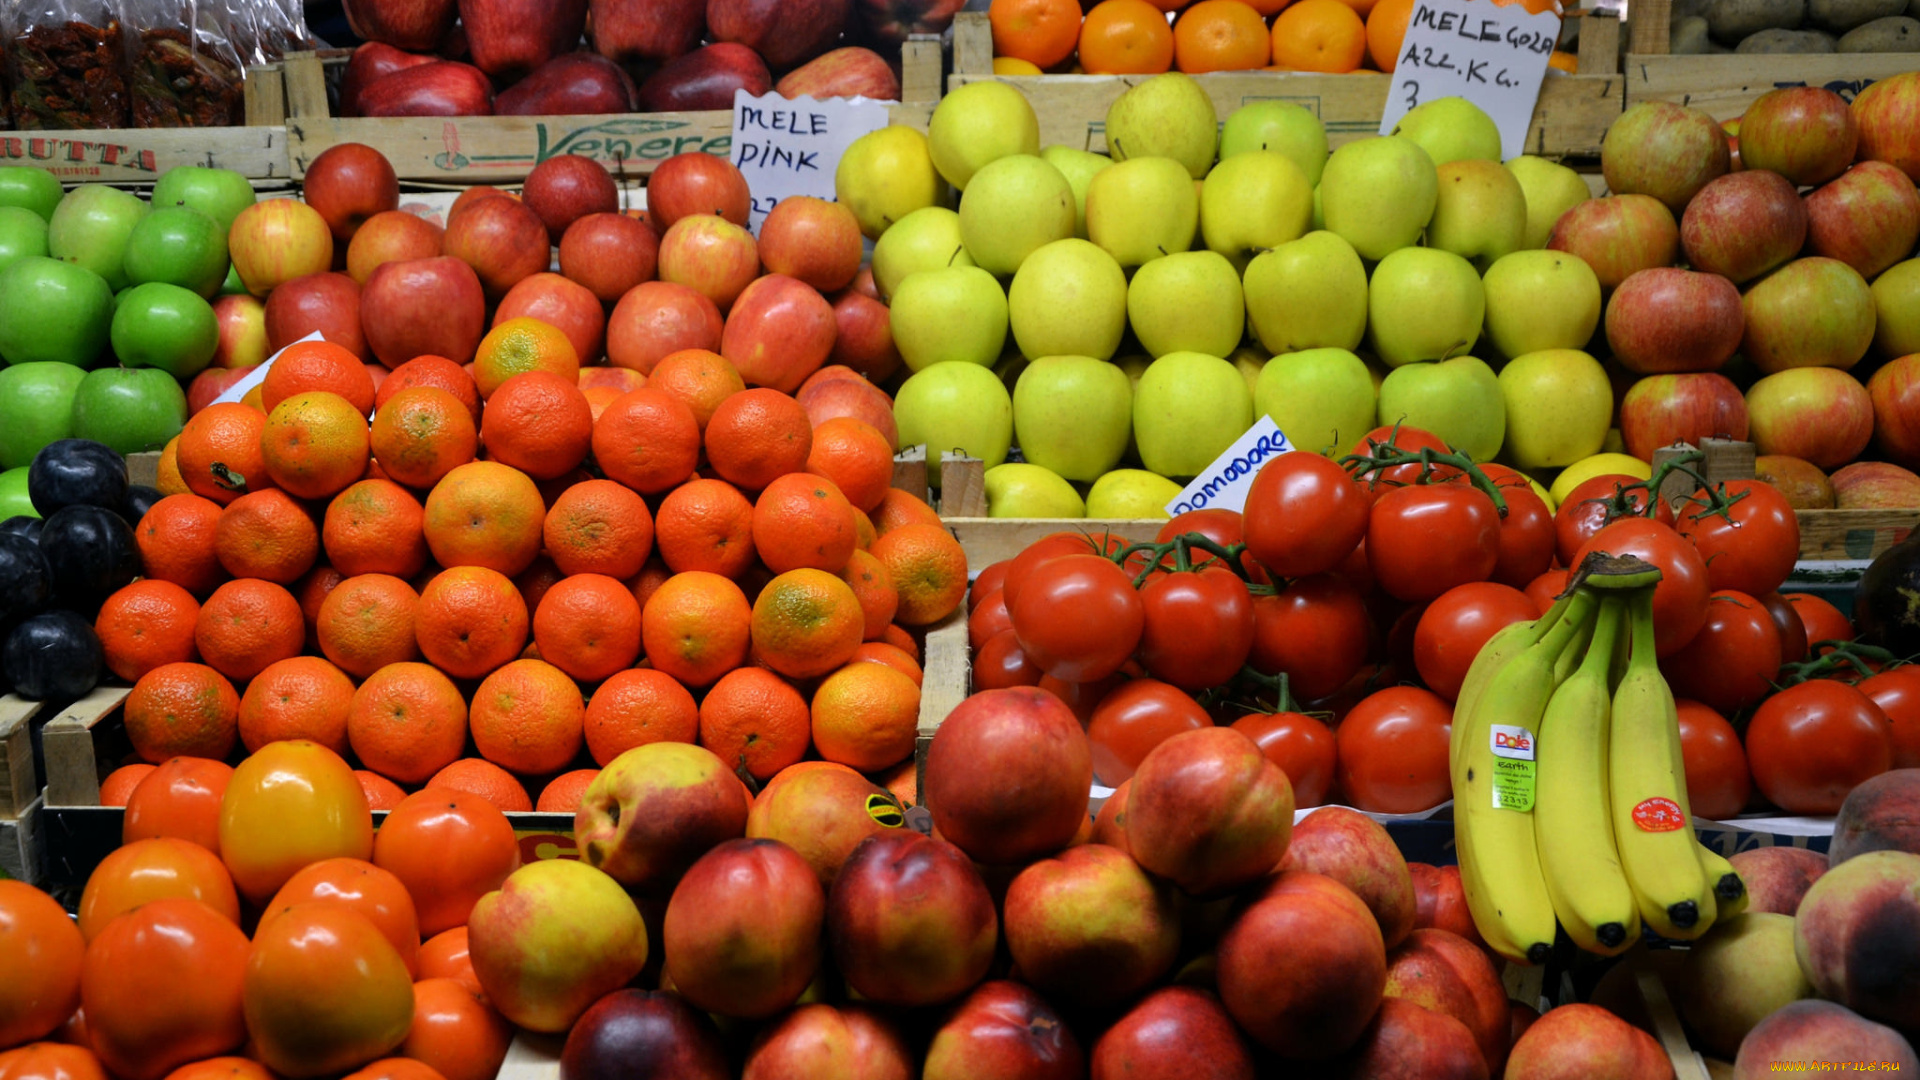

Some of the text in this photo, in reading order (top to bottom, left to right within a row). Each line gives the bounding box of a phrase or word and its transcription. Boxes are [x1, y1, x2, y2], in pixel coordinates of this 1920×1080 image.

[1413, 5, 1501, 42] MELE
[740, 105, 828, 135] MELE
[536, 119, 732, 166] Venere
[737, 140, 819, 172] PINK
[1173, 429, 1287, 515] POMODORO
[1496, 732, 1530, 750] Dole
